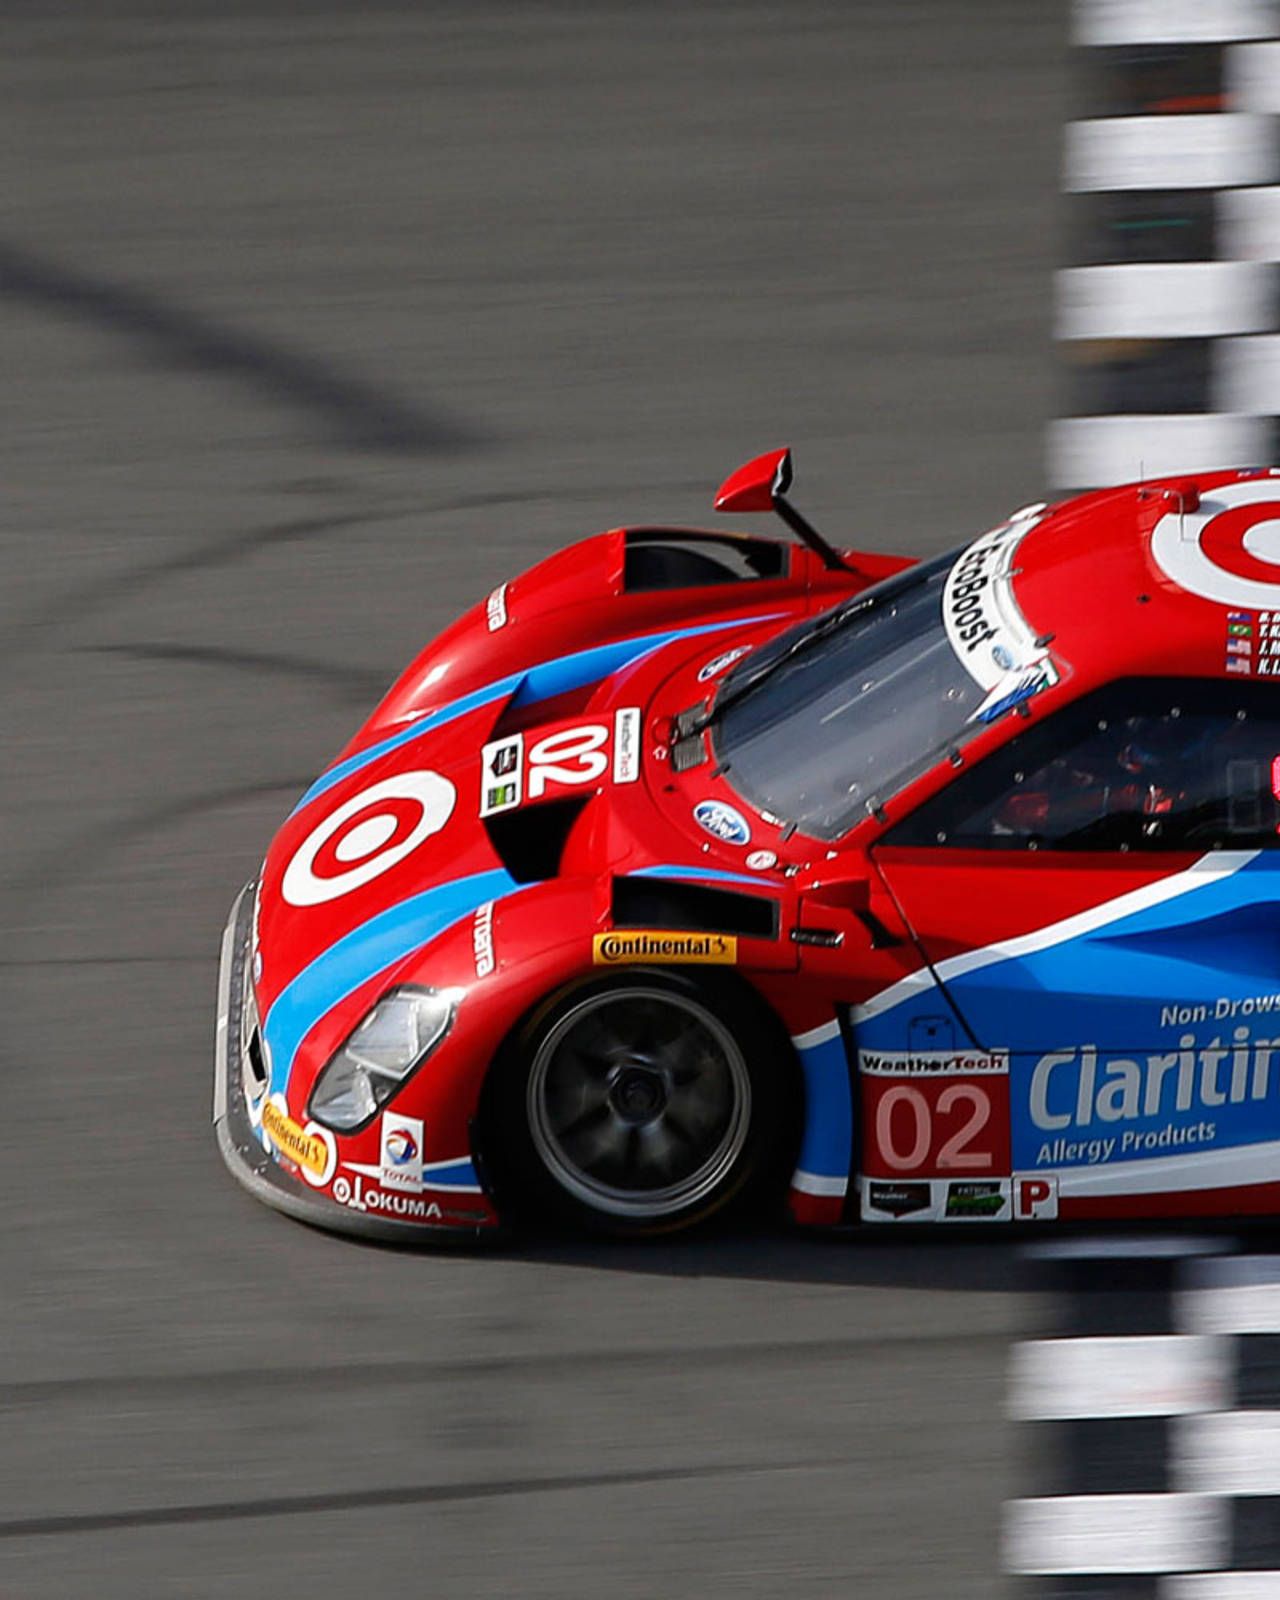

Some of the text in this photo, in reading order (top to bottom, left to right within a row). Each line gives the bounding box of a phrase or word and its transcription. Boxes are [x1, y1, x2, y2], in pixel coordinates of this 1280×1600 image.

[952, 543, 1003, 652] EcoBoost
[1259, 640, 1268, 655] J.
[1258, 659, 1270, 675] K.
[529, 725, 608, 798] 02
[600, 936, 711, 961] Continental
[863, 1054, 1002, 1072] WeatherTech
[875, 1083, 992, 1171] 02
[1036, 1121, 1216, 1165] Allergy Products
[383, 1168, 420, 1184] TOTAL
[365, 1190, 443, 1219] OKUMA
[1021, 1180, 1050, 1215] P
